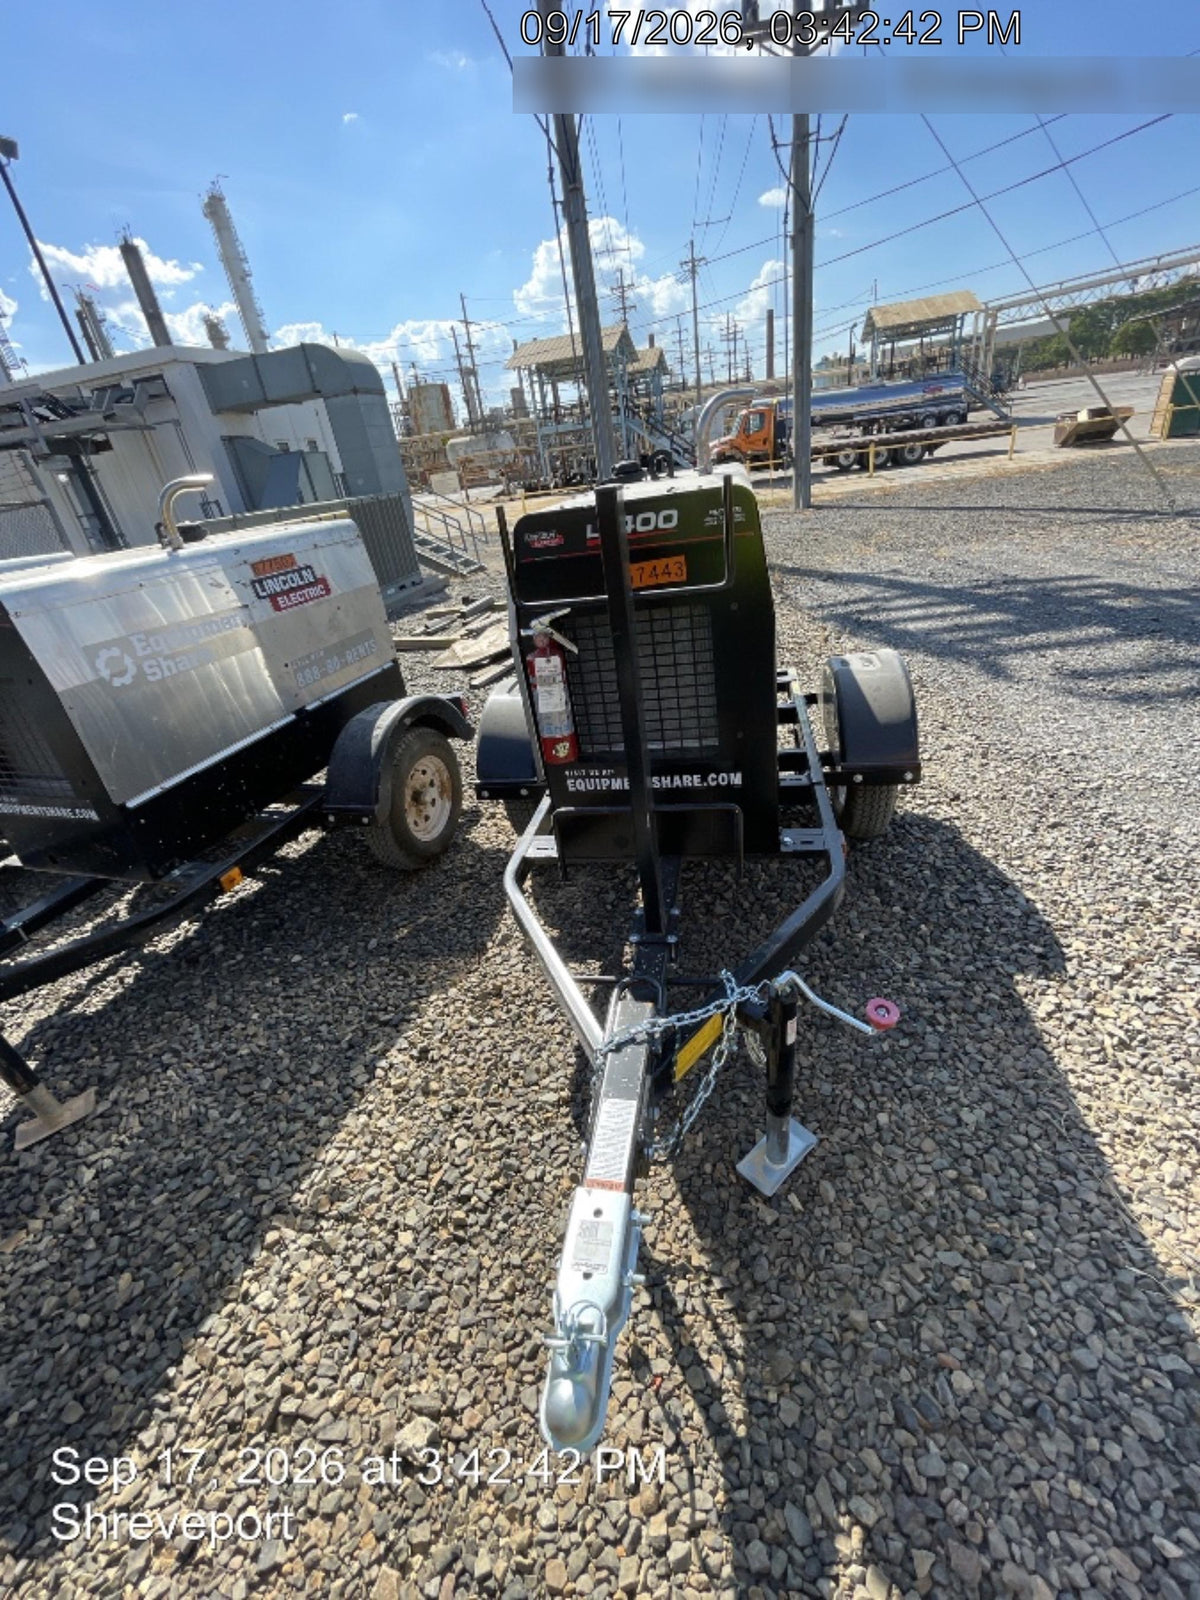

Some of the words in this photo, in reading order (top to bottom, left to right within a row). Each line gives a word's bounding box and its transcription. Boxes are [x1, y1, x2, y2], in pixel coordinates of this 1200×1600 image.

[255, 567, 316, 597] LINCOLN
[629, 560, 684, 585] 7443
[277, 584, 326, 609] ELECTRIC
[566, 772, 743, 792] EQUIPMESHARE.COM
